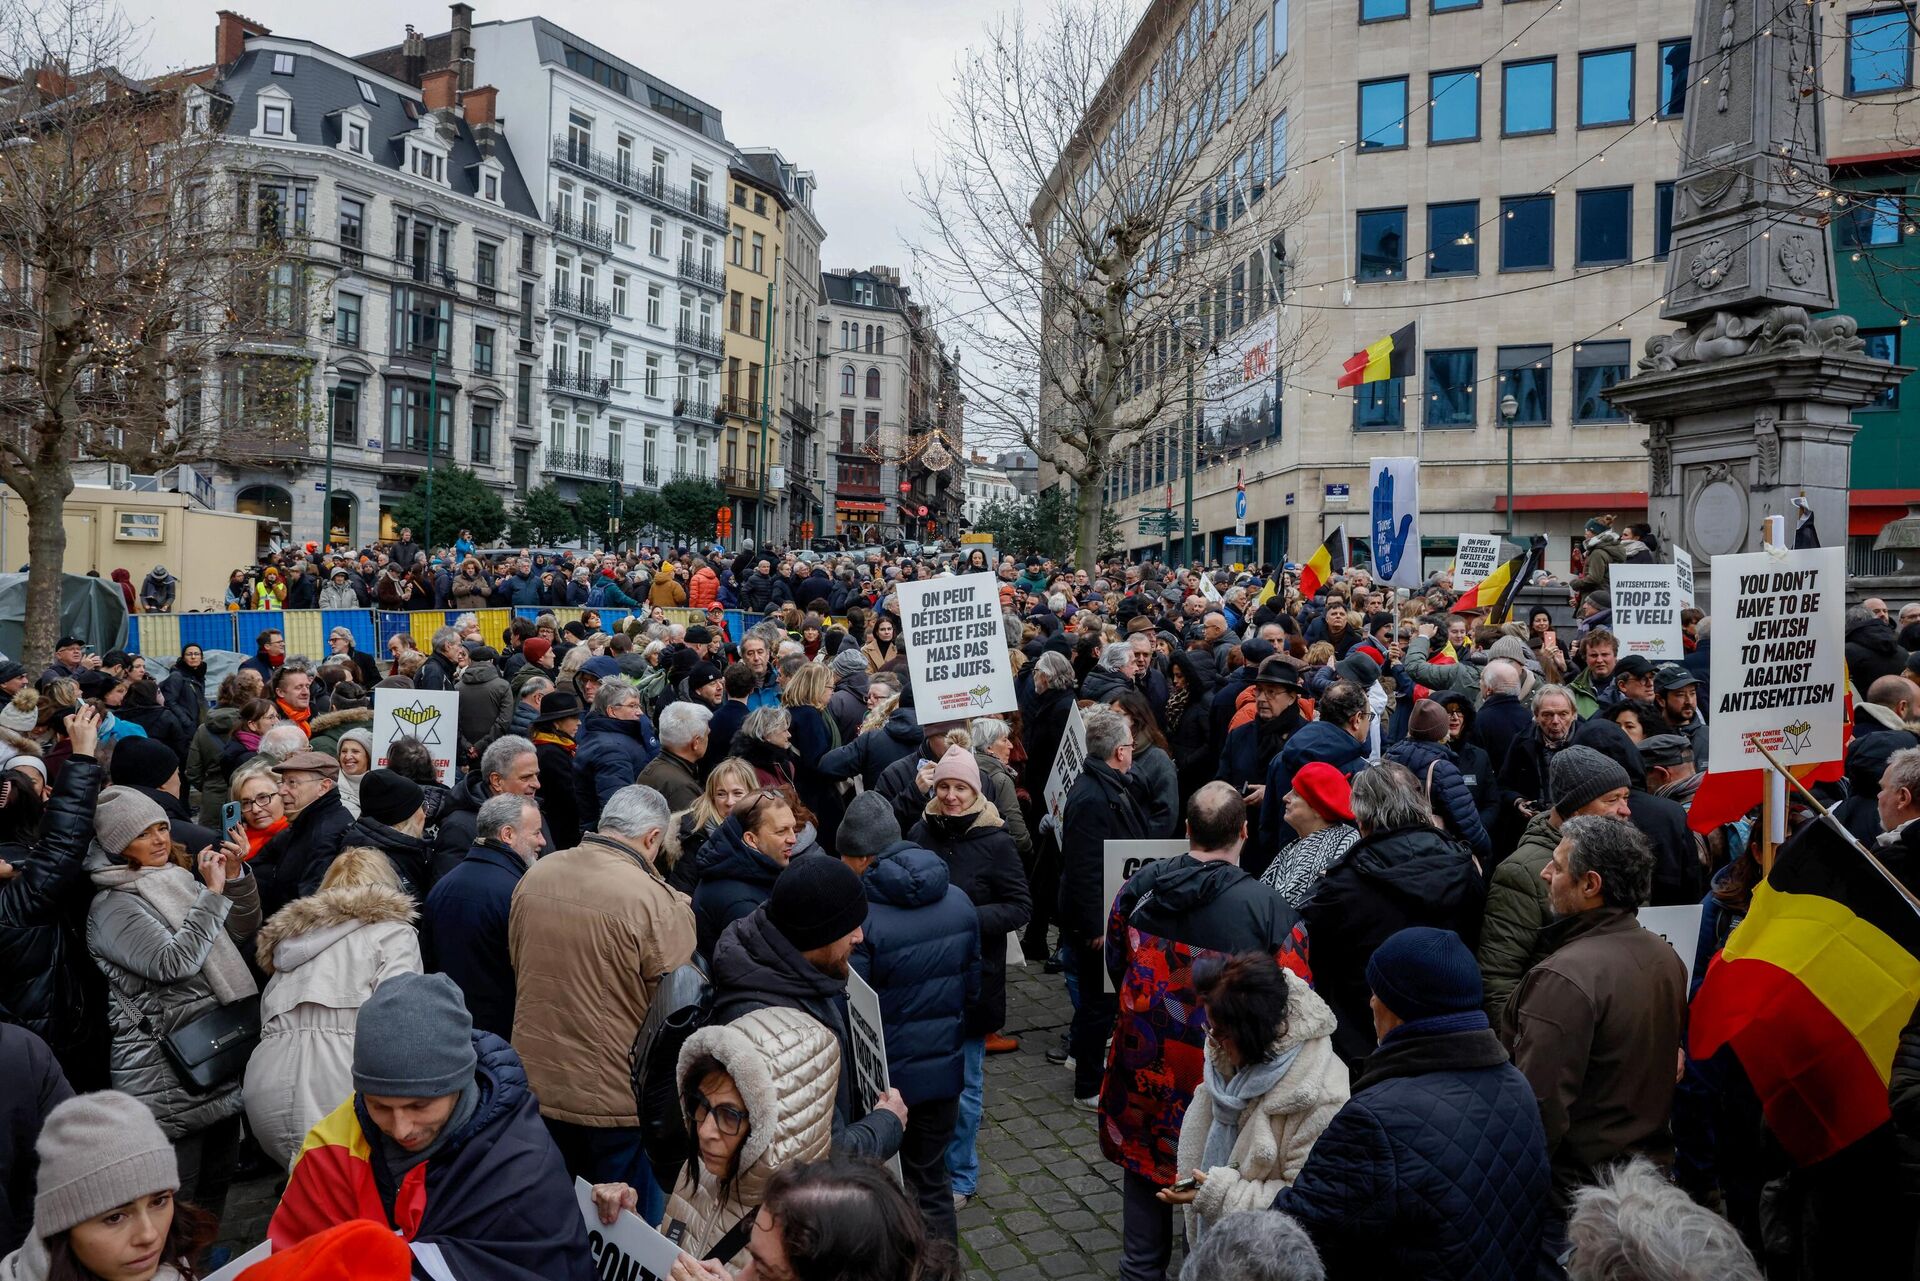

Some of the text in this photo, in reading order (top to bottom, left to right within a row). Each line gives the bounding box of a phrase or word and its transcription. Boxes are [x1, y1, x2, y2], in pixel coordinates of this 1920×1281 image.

[1616, 580, 1670, 588] ANTISEMITISME:
[1740, 574, 1770, 595] YOU
[922, 586, 976, 608] ON PEUT
[1616, 592, 1651, 606] TROP
[1654, 592, 1670, 606] IS
[1736, 592, 1820, 619] HAVE TO BE
[911, 603, 992, 628] DÉTESTER LE
[1616, 610, 1673, 624] TE VEEL!
[912, 620, 997, 646] GEFILTE FISH
[1748, 617, 1809, 642] JEWISH
[926, 640, 988, 664] MAIS PAS
[1741, 640, 1816, 665] TO MARCH
[926, 660, 995, 682] LES JUIFS.
[1744, 662, 1812, 688] AGAINST
[1719, 683, 1835, 713] ANTISEMITISM
[1056, 752, 1066, 776] TE
[1063, 734, 1078, 772] TROP
